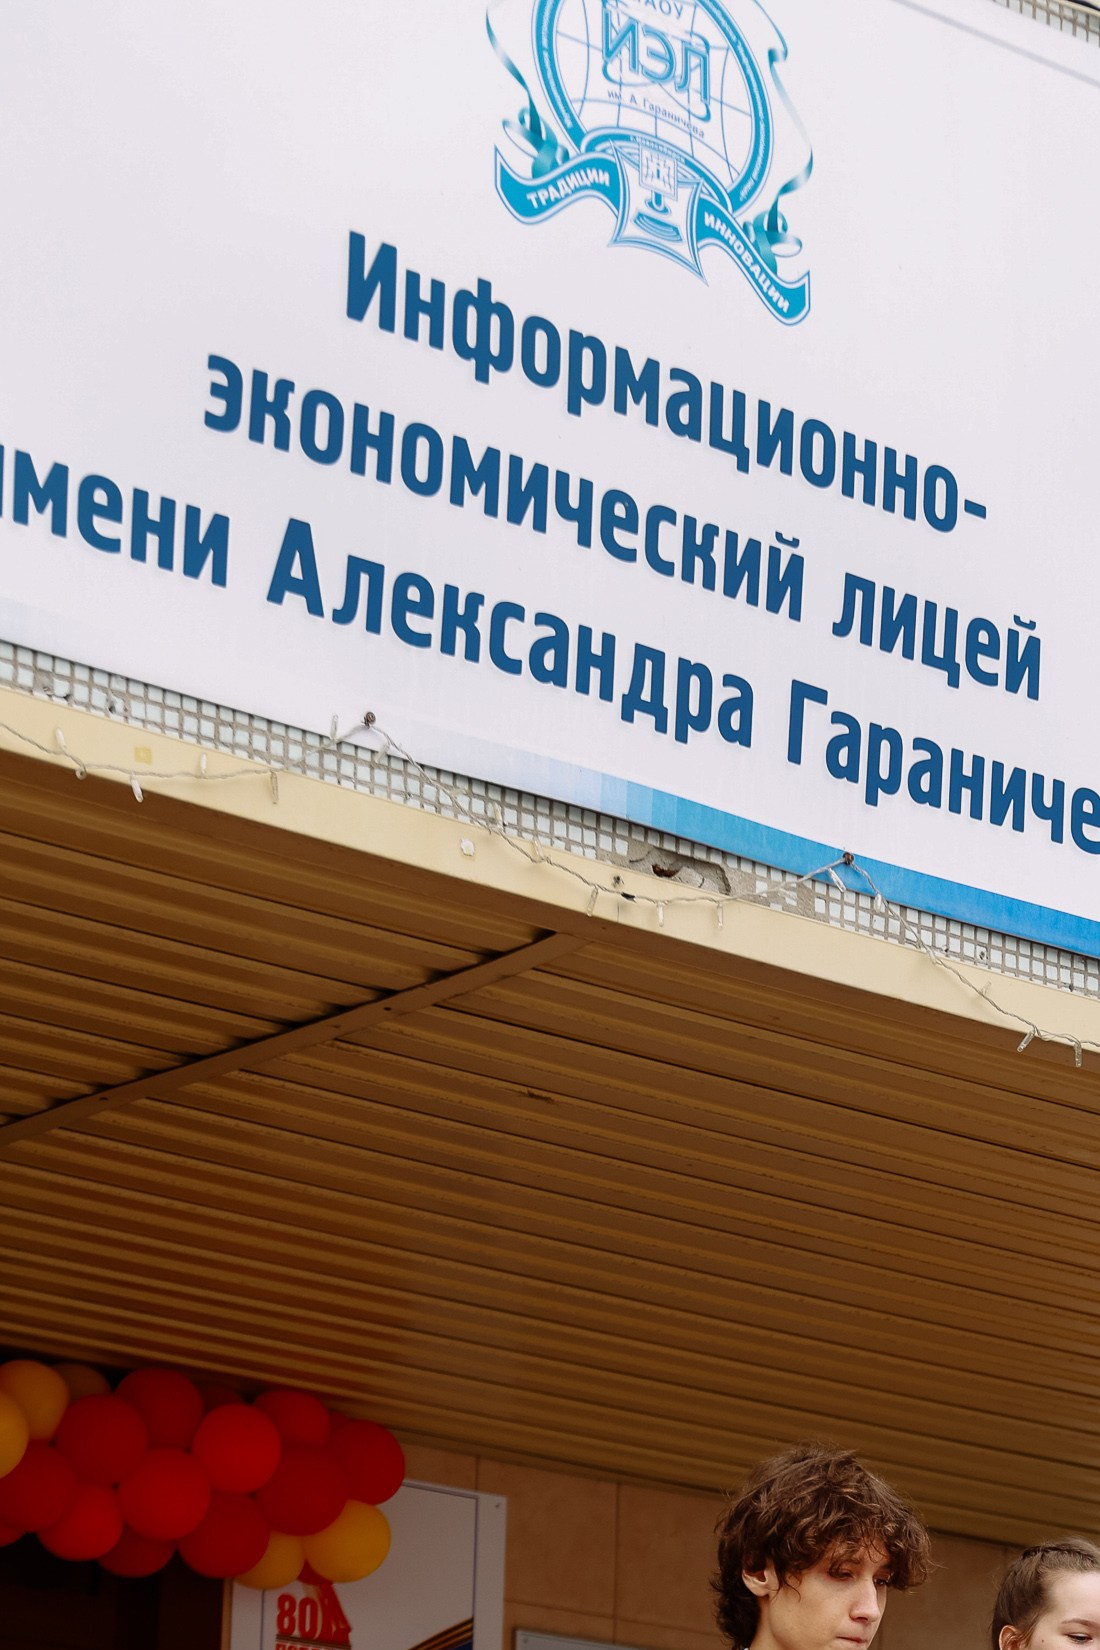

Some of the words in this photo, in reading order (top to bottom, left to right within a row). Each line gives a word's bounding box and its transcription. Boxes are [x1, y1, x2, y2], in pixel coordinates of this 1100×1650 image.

[601, 6, 711, 105] ИЭЛ
[526, 166, 610, 209] ТРАДИЦИИ
[704, 211, 790, 314] ИННОВАЦИИ
[346, 229, 988, 533] Информационно-
[203, 354, 806, 623] экономический
[832, 571, 1042, 703] лицей
[265, 517, 755, 749] Александра
[276, 1593, 320, 1639] 80
